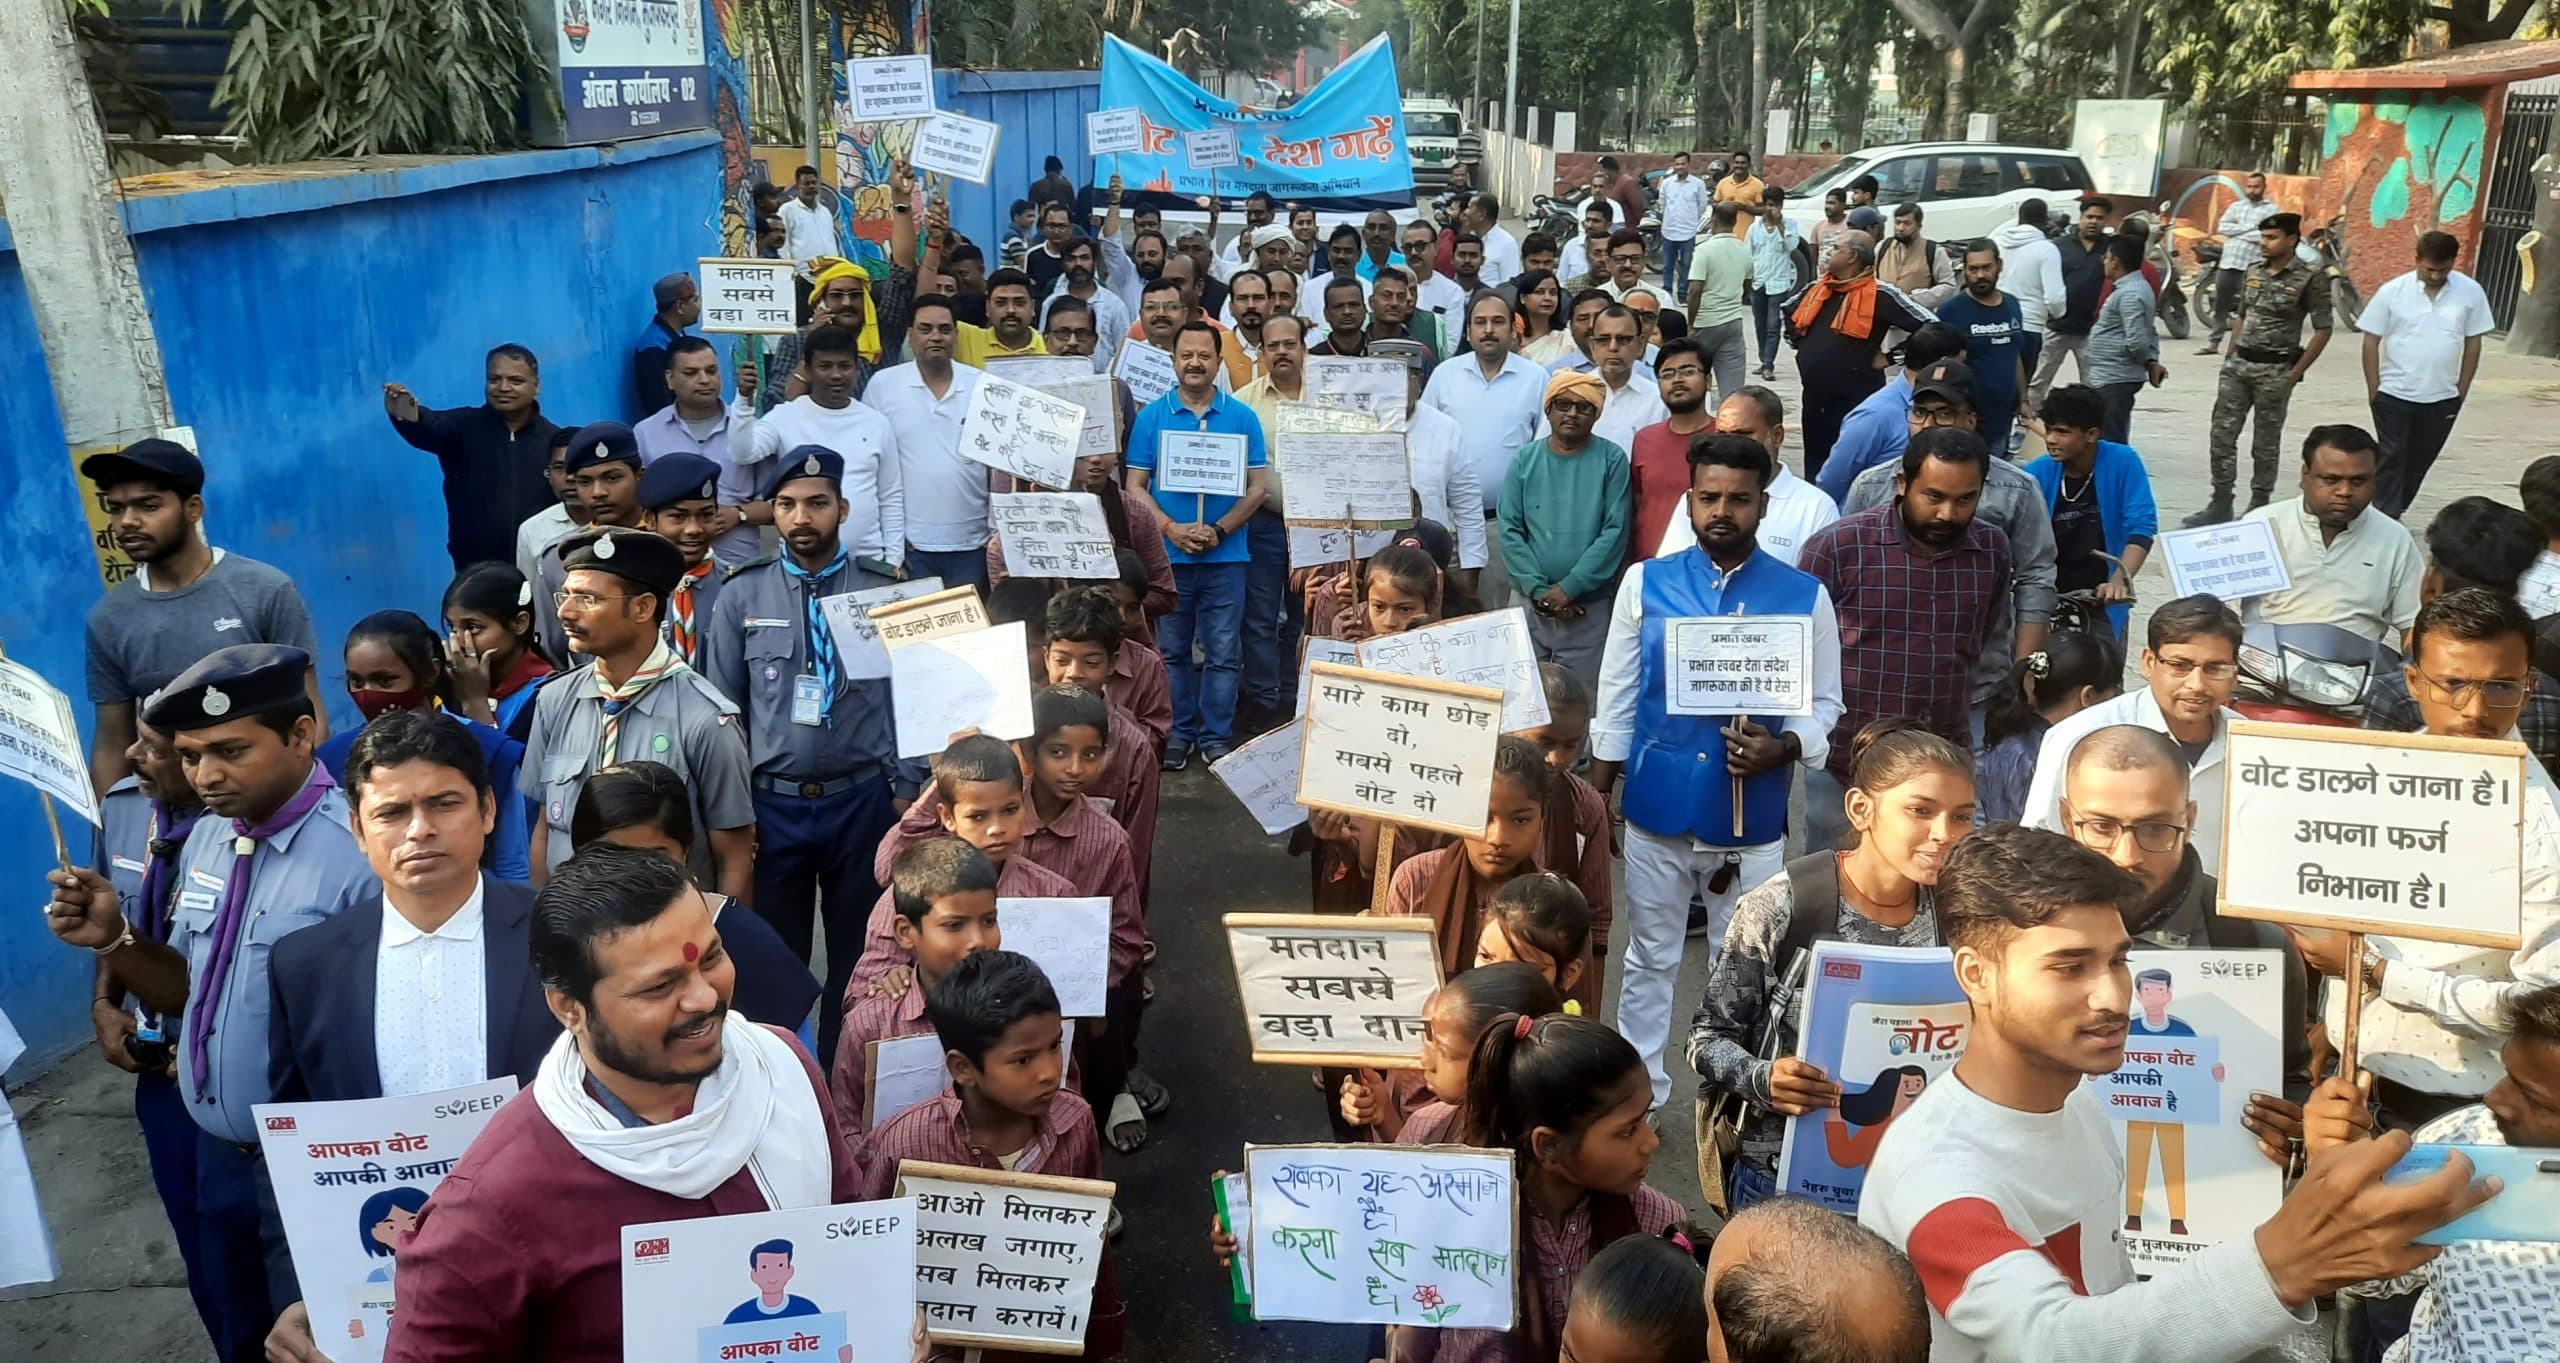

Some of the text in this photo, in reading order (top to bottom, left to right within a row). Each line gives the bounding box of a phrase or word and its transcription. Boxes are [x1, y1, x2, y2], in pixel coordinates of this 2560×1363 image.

[582, 71, 619, 109] अंचल
[620, 70, 671, 106] कार्यालय
[680, 77, 697, 101] 02
[1261, 135, 1323, 168] देश
[1327, 116, 1394, 161] गढ़ें
[1234, 181, 1267, 193] मतदाता
[1320, 177, 1360, 192] अभियान
[718, 267, 774, 281] मतदान
[721, 284, 775, 302] सबसे
[708, 308, 790, 324] बड़ा दान
[1970, 322, 2011, 335] Reebok
[883, 622, 905, 640] वोट
[902, 613, 935, 637] डालने
[933, 610, 964, 628] जाना
[963, 602, 981, 623] है।
[1710, 633, 1768, 644] प्रभात खबर
[1717, 659, 1742, 673] खबर
[1744, 656, 1761, 672] देता
[1763, 656, 1790, 672] संदेश
[1689, 677, 1791, 694] जागरूकता की है ये रेस
[1322, 684, 1365, 708] सारे
[1380, 694, 1430, 719] काम
[1446, 702, 1492, 731] छोड़
[1386, 723, 1417, 750] दो,
[1335, 749, 1464, 787] सबसे पहले
[2241, 755, 2510, 807] वोट डालने जाना है।
[1355, 780, 1438, 813] वोट दो
[2294, 817, 2450, 854] अपना फर्ज
[2296, 862, 2447, 910] निभाना है।
[1266, 935, 1388, 960] मतदान
[2200, 959, 2268, 978] SWEEP
[1281, 967, 1395, 1001] सबसे
[1259, 1014, 1433, 1042] बड़ा दान
[2165, 1047, 2196, 1066] वोट
[2109, 1069, 2163, 1088] आपकी
[434, 1094, 505, 1120] SWEEP
[2109, 1089, 2178, 1112] आवाज है
[307, 1132, 429, 1159] आपका वोट
[313, 1157, 459, 1187] आपकी आवा
[1360, 1168, 1403, 1197] यह
[1405, 1163, 1508, 1216] अरमान
[1831, 1186, 1856, 1198] युवा
[916, 1191, 1097, 1228] आओ मिलकर
[825, 1215, 901, 1240] SWEEP
[916, 1228, 1084, 1266] अलख जगाए,
[1272, 1225, 1509, 1289] करना सब मतदान
[916, 1263, 1070, 1296] सब मिलकर
[996, 1305, 1078, 1333] करायें।
[719, 1330, 821, 1361] आपका वोट
